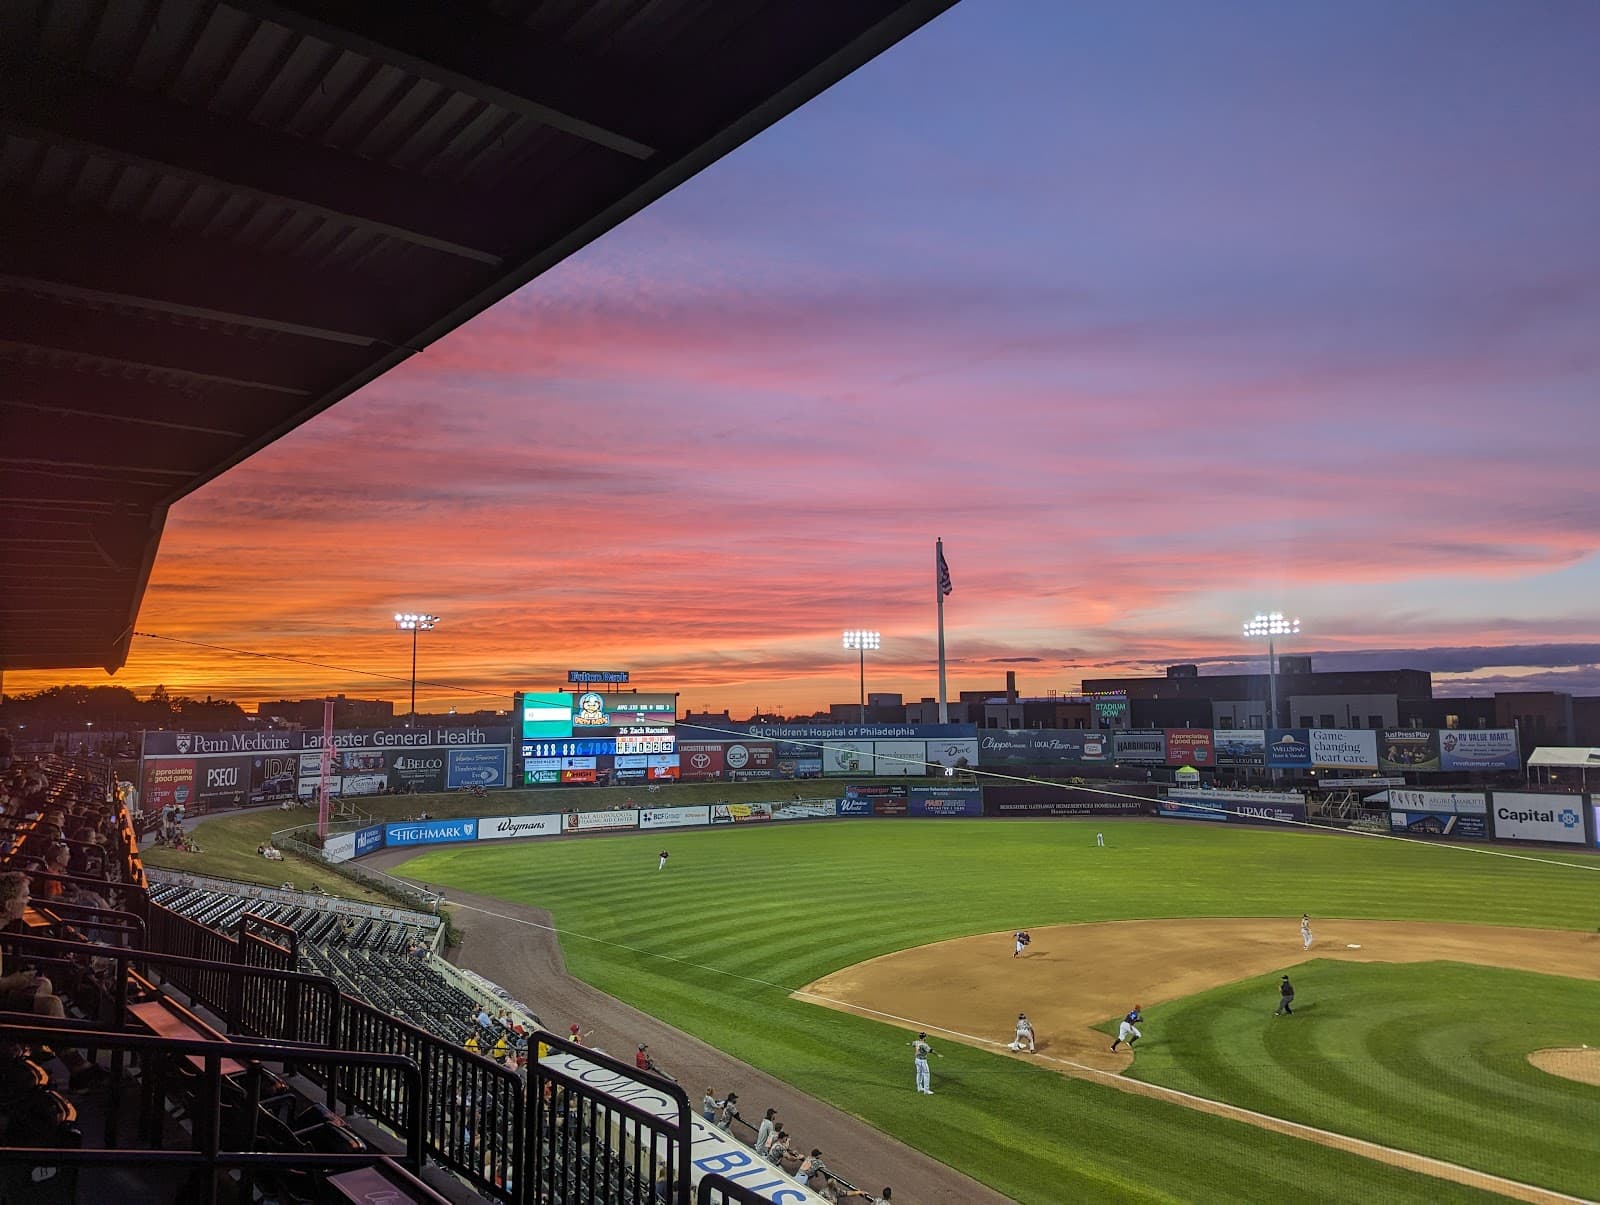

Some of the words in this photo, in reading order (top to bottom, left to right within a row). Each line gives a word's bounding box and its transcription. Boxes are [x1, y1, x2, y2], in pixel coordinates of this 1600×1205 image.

[571, 672, 602, 682] Fulton
[602, 672, 628, 682] Bank
[1095, 703, 1126, 711] STADIUM
[1102, 710, 1120, 718] ROW
[619, 726, 628, 734] 26
[630, 726, 644, 734] Zach
[646, 726, 668, 734] Racusin
[765, 728, 808, 737] Children's
[810, 728, 846, 738] Hospital
[848, 728, 859, 736] of
[860, 727, 916, 738] Philadelphia
[194, 735, 229, 752] Penn
[232, 731, 290, 752] Medicine
[302, 732, 368, 749] Lancaster
[373, 730, 432, 746] General
[437, 729, 486, 744] Health
[1314, 731, 1346, 741] Game-
[1458, 733, 1467, 742] RV
[1468, 733, 1488, 742] VALUE
[1489, 733, 1509, 742] MART
[662, 742, 672, 751] 82
[981, 736, 1012, 751] Clipper
[1034, 741, 1049, 749] LOCAL
[1175, 738, 1190, 746] good
[1314, 741, 1361, 754] changing
[1315, 752, 1342, 762] heart
[1344, 754, 1368, 763] care.
[406, 758, 443, 769] BELCO
[151, 768, 193, 777] Appreciating
[944, 767, 954, 776] 20
[154, 775, 173, 784] good
[207, 768, 238, 787] PSECU
[1236, 806, 1274, 818] UPMC
[1498, 807, 1554, 824] Capital
[497, 818, 546, 836] Wegmans
[397, 827, 460, 841] HIGHMARK
[564, 1058, 726, 1144] COMCT
